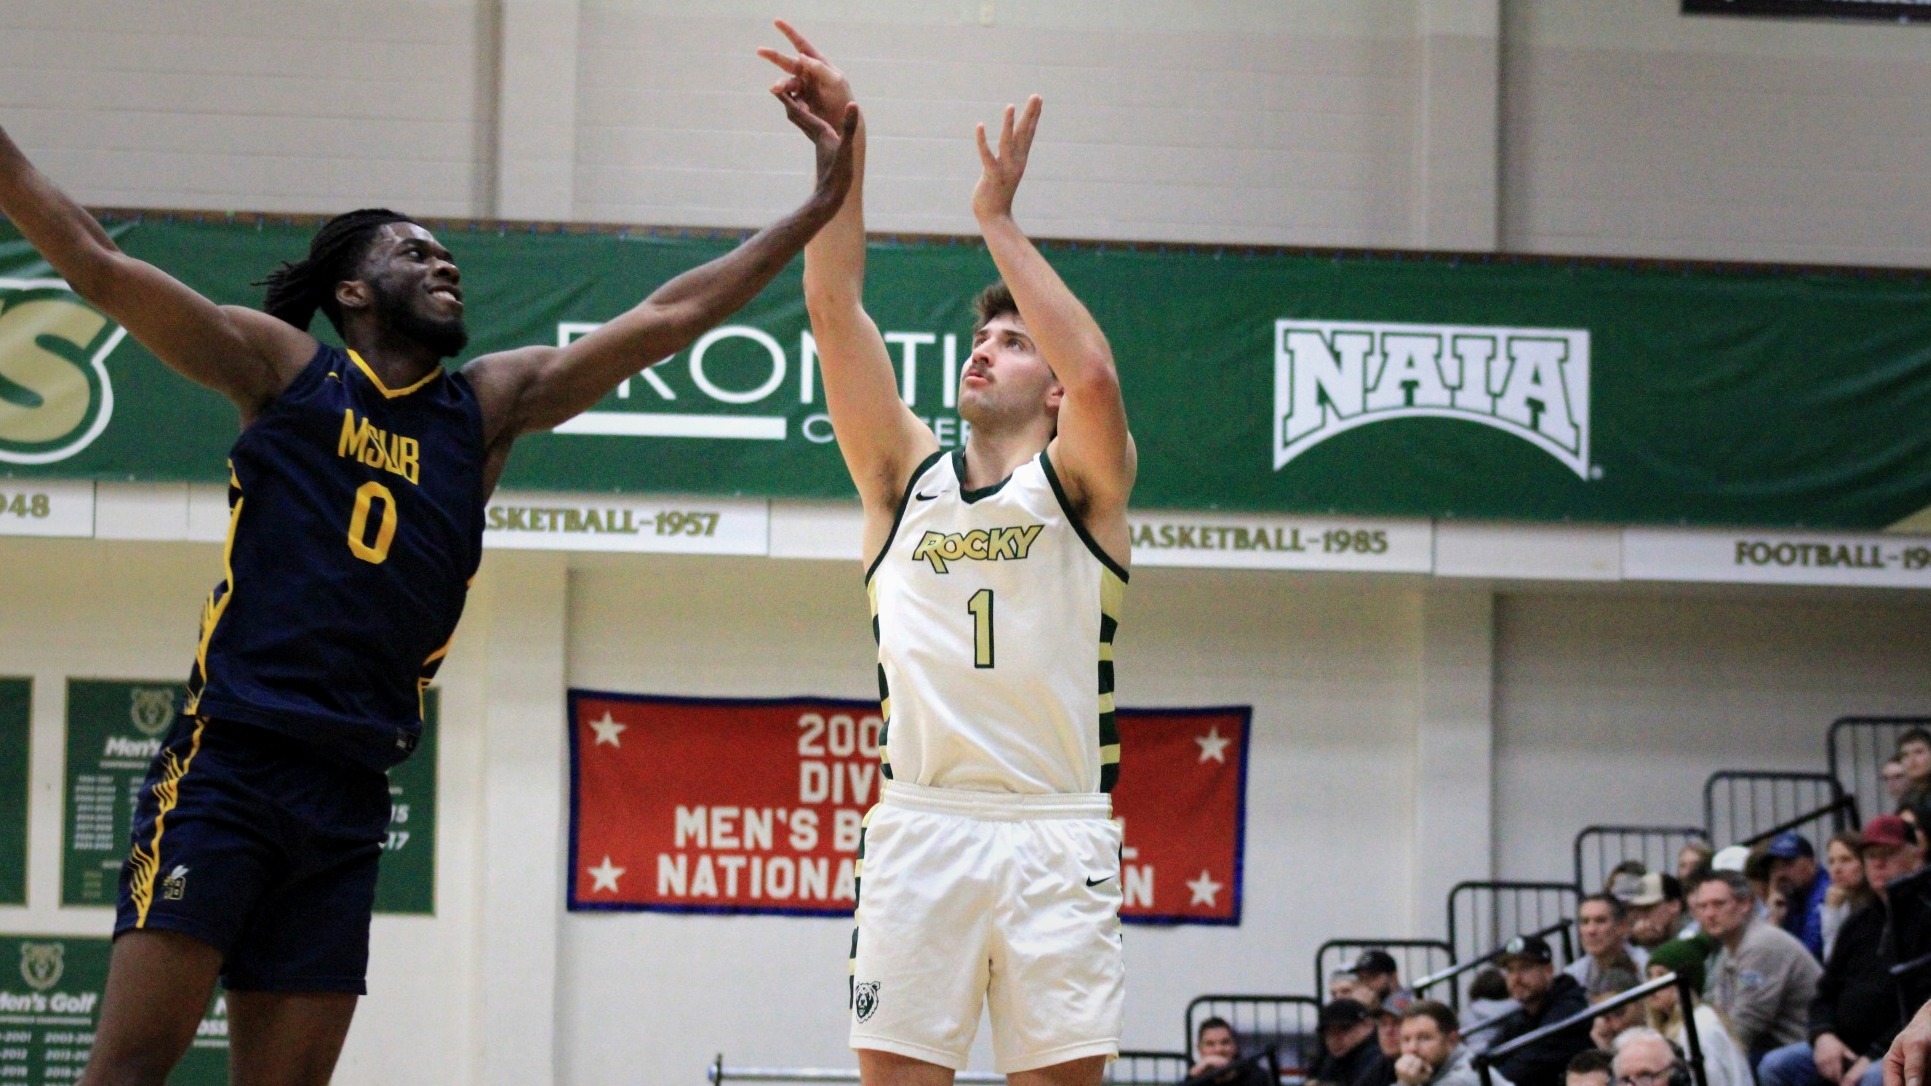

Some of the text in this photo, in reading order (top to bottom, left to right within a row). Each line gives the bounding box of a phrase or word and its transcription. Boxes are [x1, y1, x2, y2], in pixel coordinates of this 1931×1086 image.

[1277, 322, 1586, 472] NAIA
[338, 408, 430, 485] MSUB
[348, 481, 397, 564] 0
[485, 505, 721, 538] SKETBALL-1957
[912, 524, 1045, 574] ROCKY
[967, 588, 994, 668] 1
[800, 761, 881, 805] DIV
[674, 805, 819, 851] MEN'S
[51, 992, 97, 1013] Golf
